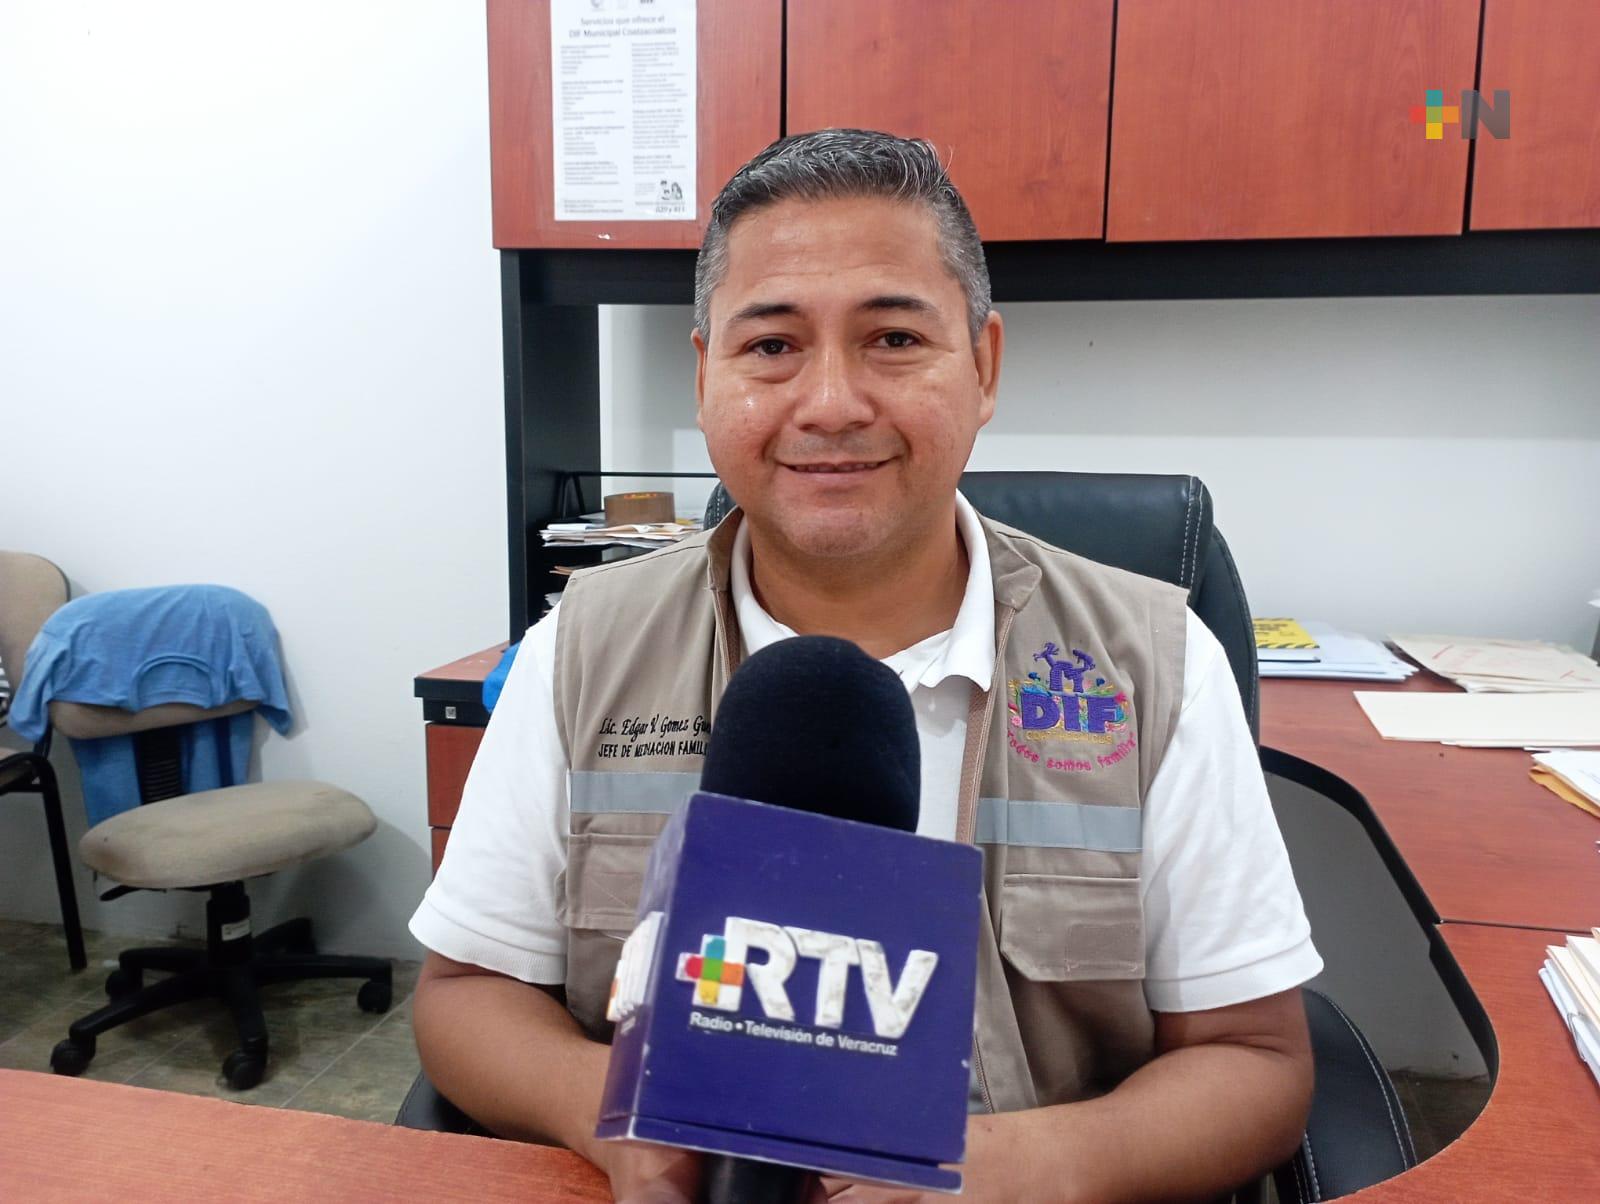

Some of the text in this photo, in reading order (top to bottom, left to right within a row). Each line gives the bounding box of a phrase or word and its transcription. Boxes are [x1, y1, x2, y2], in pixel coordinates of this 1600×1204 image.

[598, 717, 617, 735] Lic.
[621, 716, 648, 742] Edgar
[1021, 691, 1119, 734] DIF
[598, 743, 619, 758] JEFE
[621, 743, 633, 758] DE
[722, 915, 940, 1040] RTV
[689, 1011, 899, 1057] Radio Televisión de Veracruz
